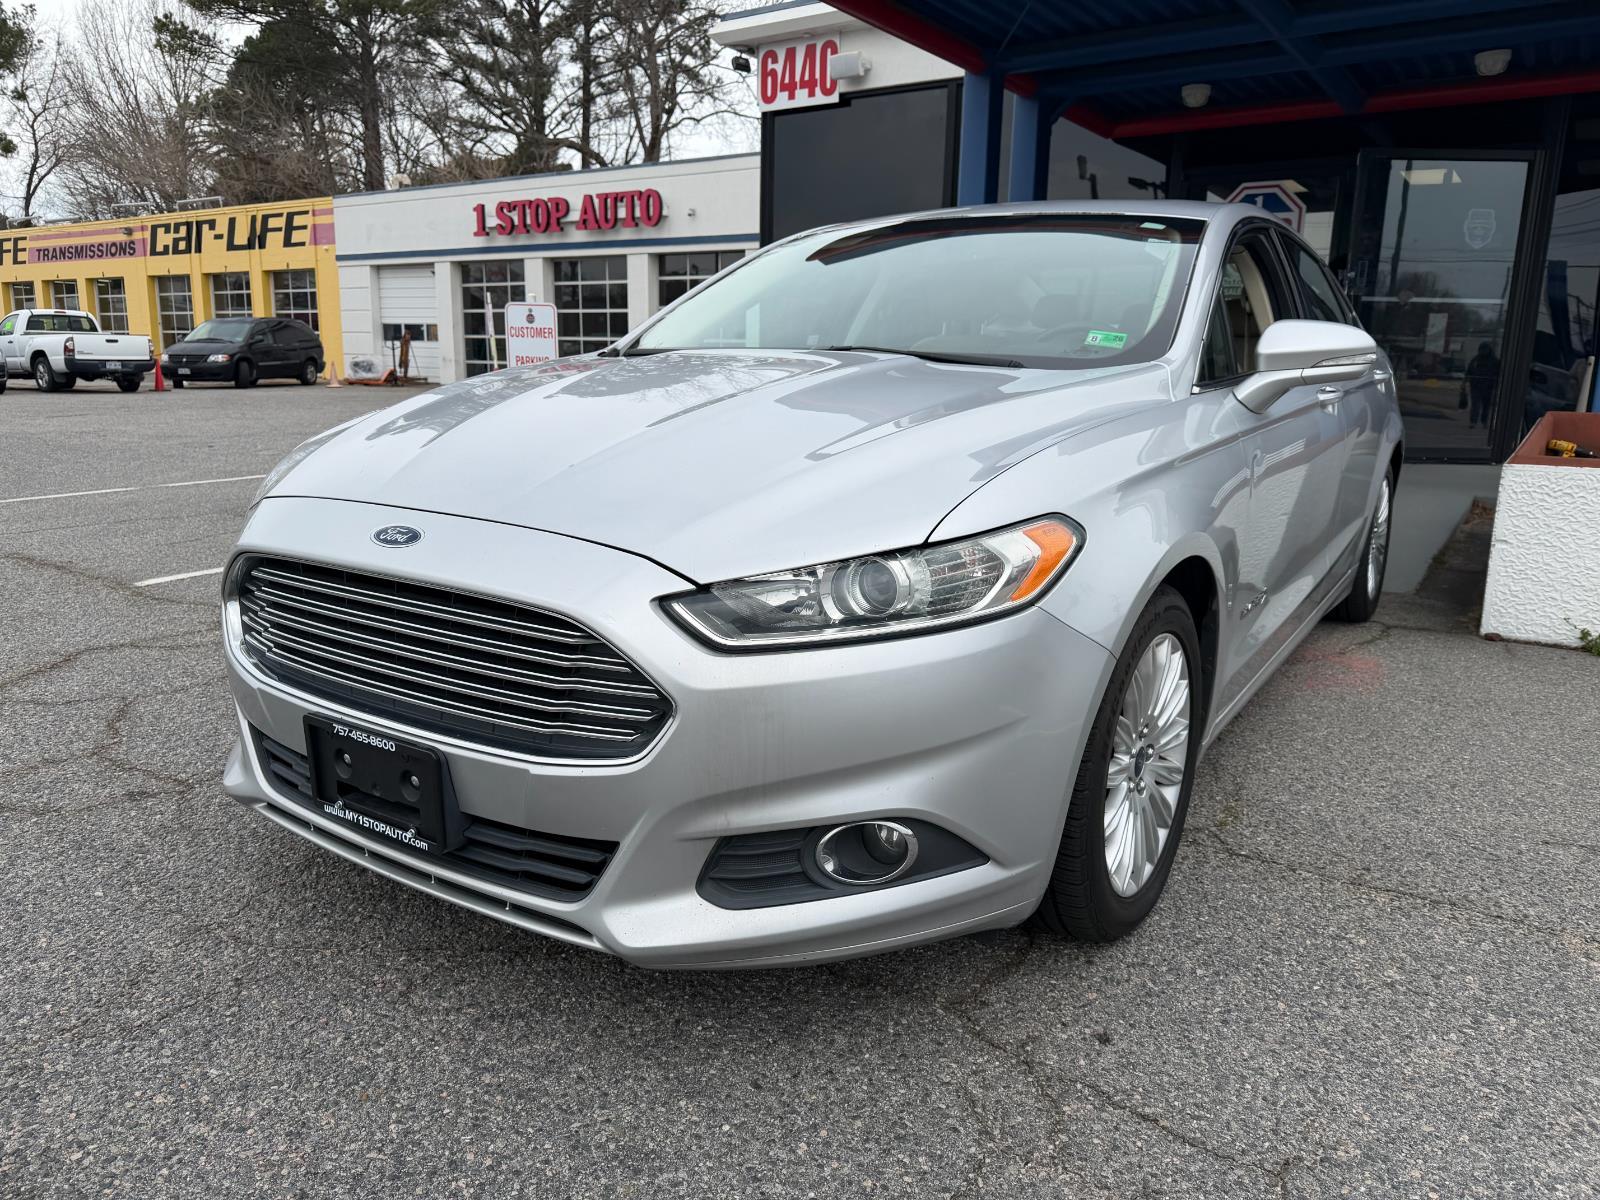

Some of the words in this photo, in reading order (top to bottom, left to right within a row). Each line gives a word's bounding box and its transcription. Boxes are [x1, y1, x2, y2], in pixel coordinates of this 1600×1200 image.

[761, 39, 838, 105] 6440
[473, 203, 489, 237] 1
[496, 197, 570, 236] STOP
[576, 188, 663, 231] AUTO
[36, 240, 137, 262] TRANSMISSIONS
[509, 326, 554, 339] CUSTOMER
[379, 527, 413, 542] Ford
[332, 723, 396, 752] 757-455-8600
[323, 803, 429, 851] www.MY1STOPAUTO.com
